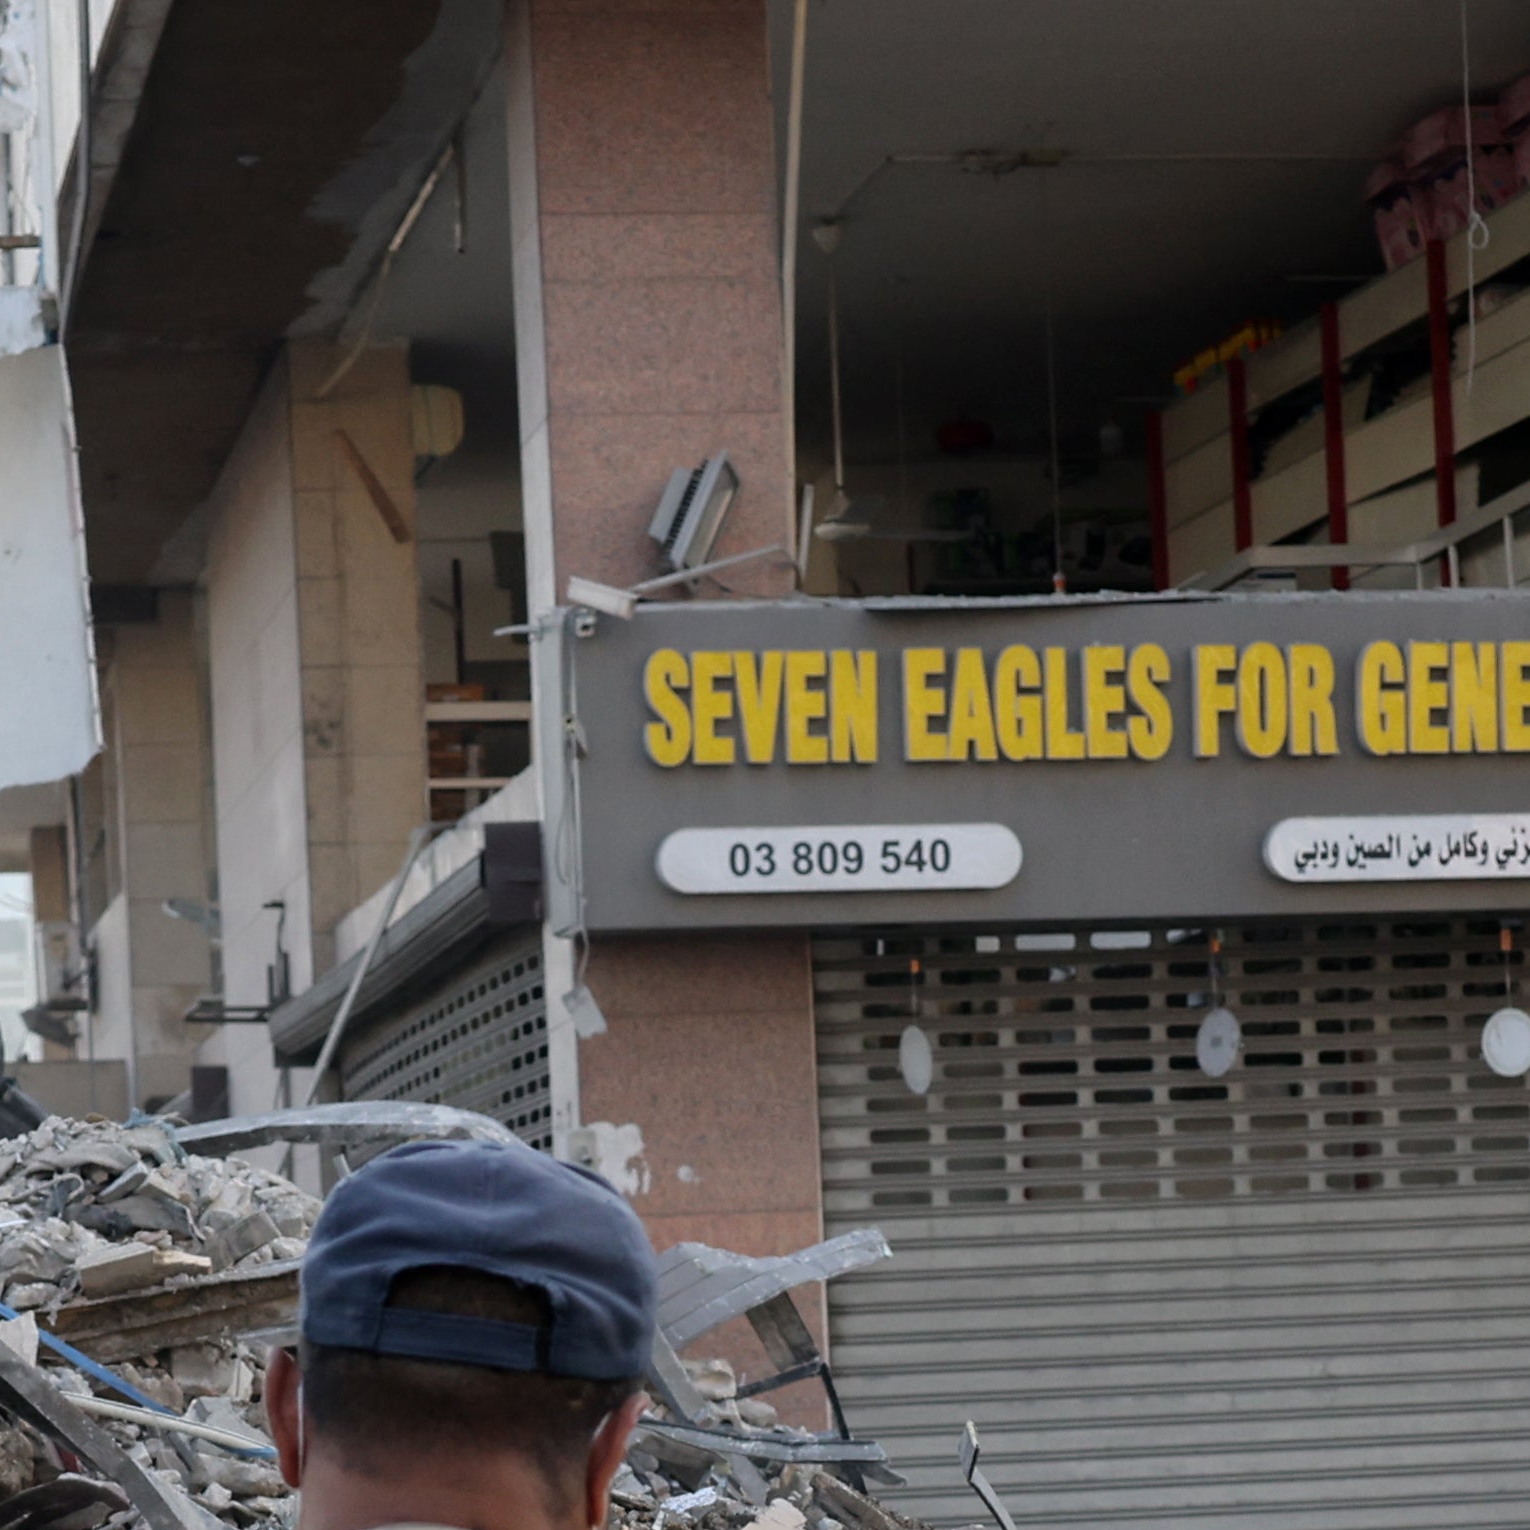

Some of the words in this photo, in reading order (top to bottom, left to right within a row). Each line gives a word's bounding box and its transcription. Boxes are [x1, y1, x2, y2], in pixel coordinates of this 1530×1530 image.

[646, 648, 879, 767] SEVEN
[903, 643, 1175, 762] EAGLES
[1195, 641, 1340, 758] FOR
[728, 842, 777, 878] 03
[792, 840, 865, 876] 809
[880, 838, 952, 875] 540
[1293, 838, 1340, 872] ودبي
[1345, 833, 1401, 870] الصين
[1408, 833, 1433, 868] من
[1439, 830, 1489, 866] وكامل
